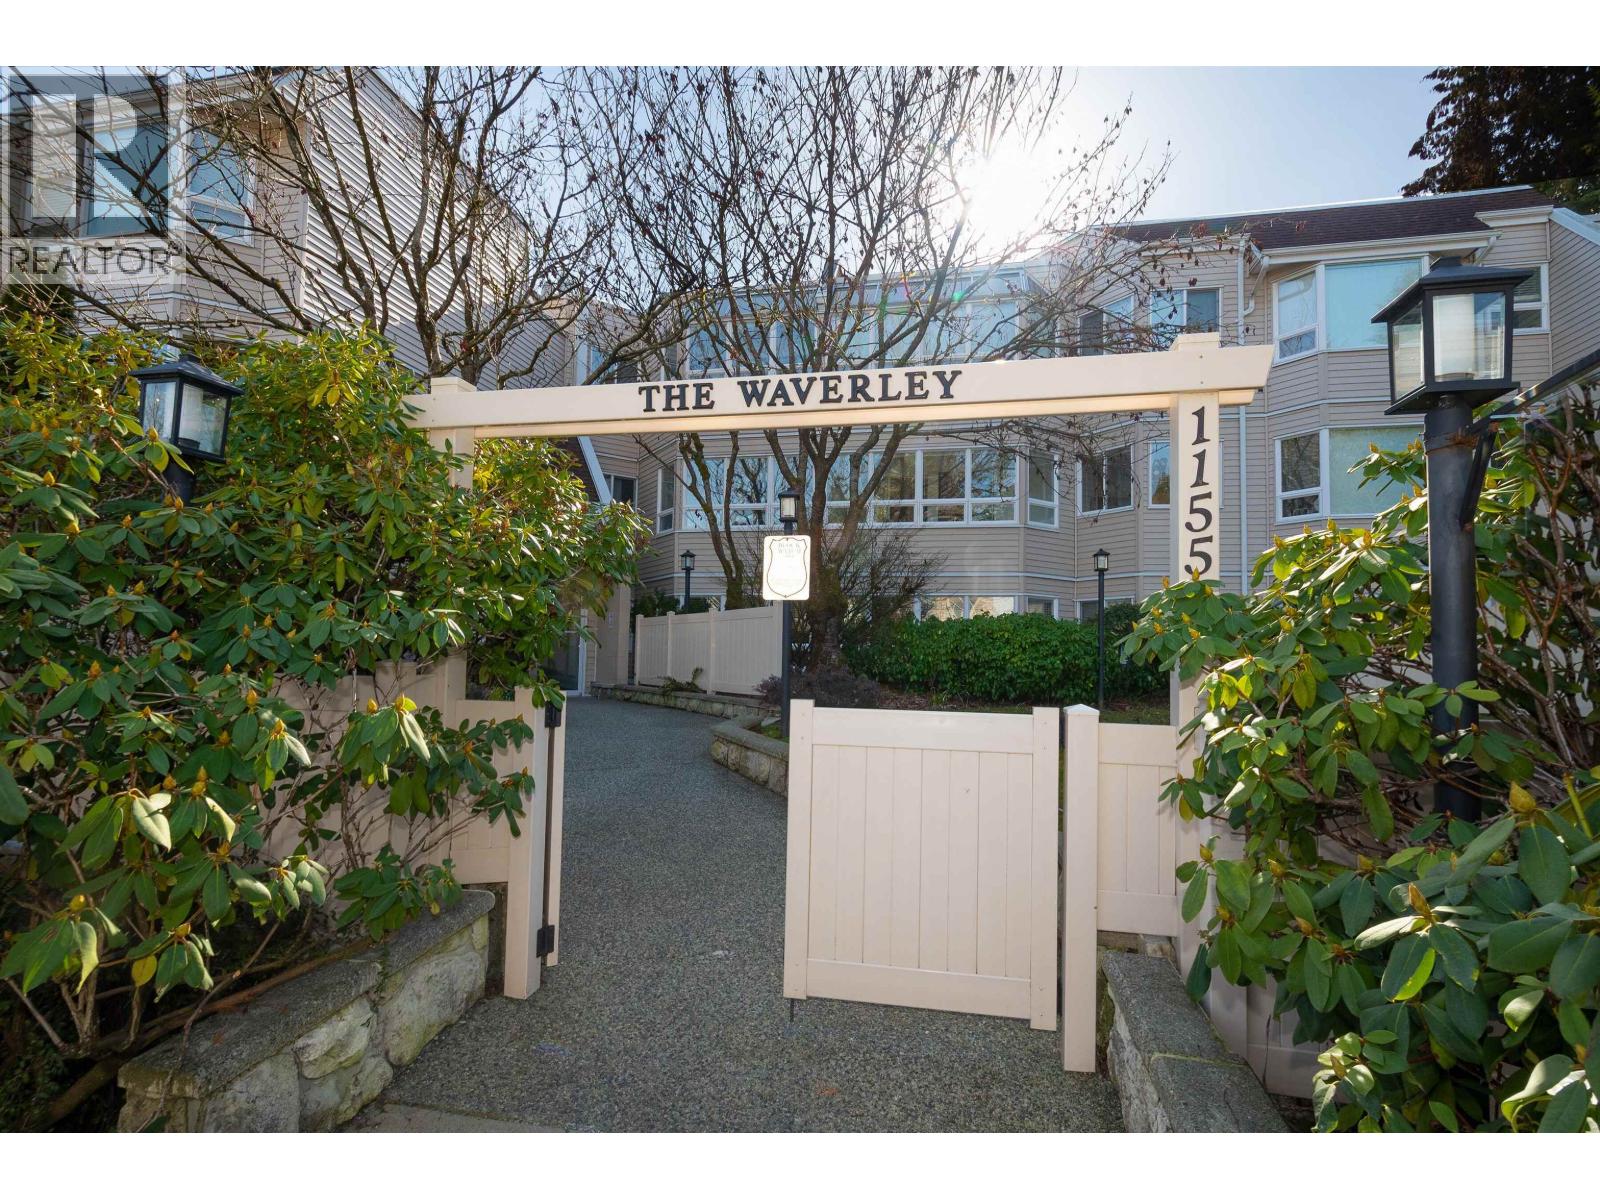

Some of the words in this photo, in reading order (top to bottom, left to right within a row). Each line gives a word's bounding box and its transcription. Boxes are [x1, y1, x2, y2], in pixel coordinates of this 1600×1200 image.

[638, 382, 716, 413] THE
[736, 370, 963, 408] WAVERLEY
[1184, 405, 1214, 577] 1155
